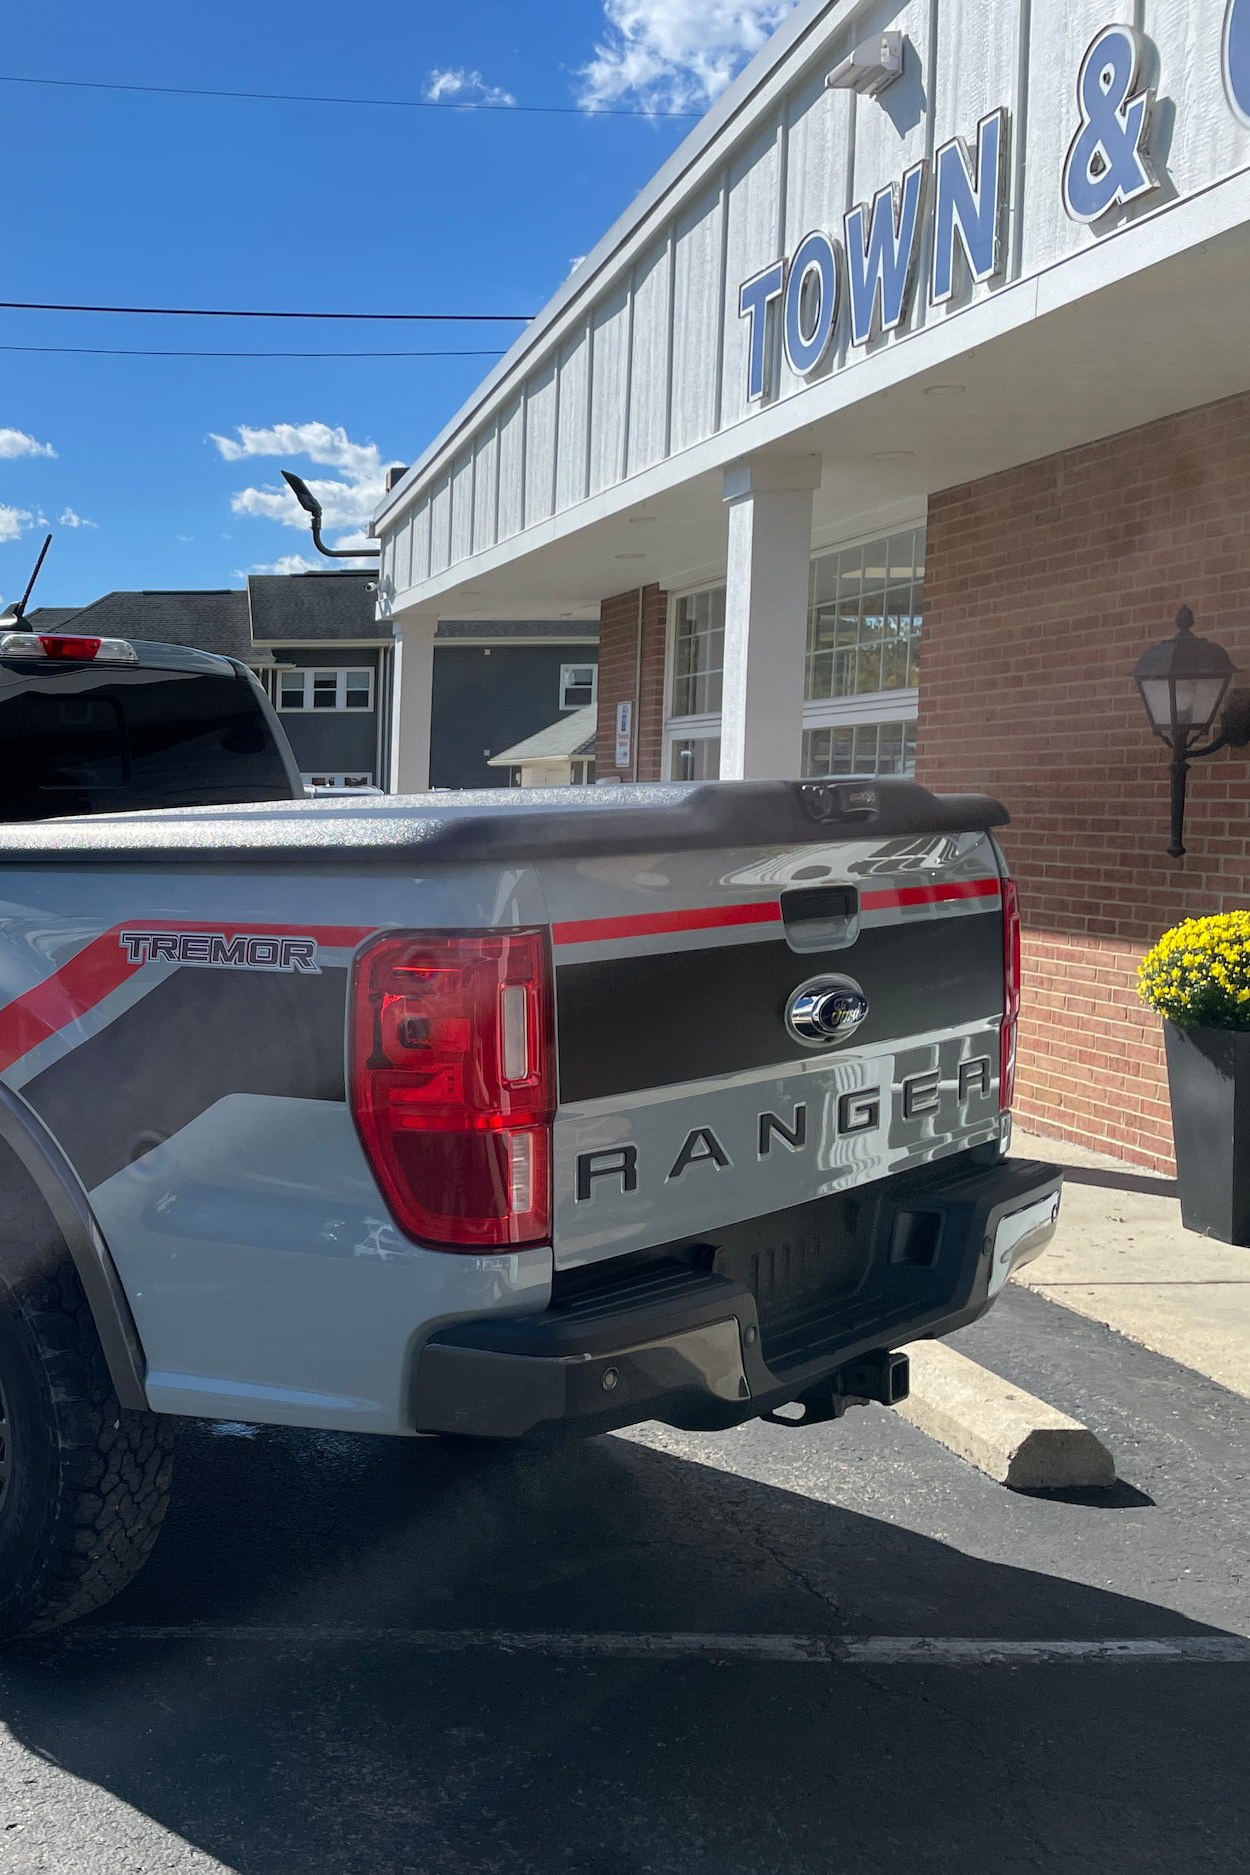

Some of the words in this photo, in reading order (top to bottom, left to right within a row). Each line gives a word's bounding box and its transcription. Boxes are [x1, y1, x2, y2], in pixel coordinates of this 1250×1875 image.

[739, 107, 1010, 403] TOWN
[1062, 23, 1158, 224] &
[120, 931, 322, 974] TREMOR
[575, 1055, 991, 1204] RANGER
